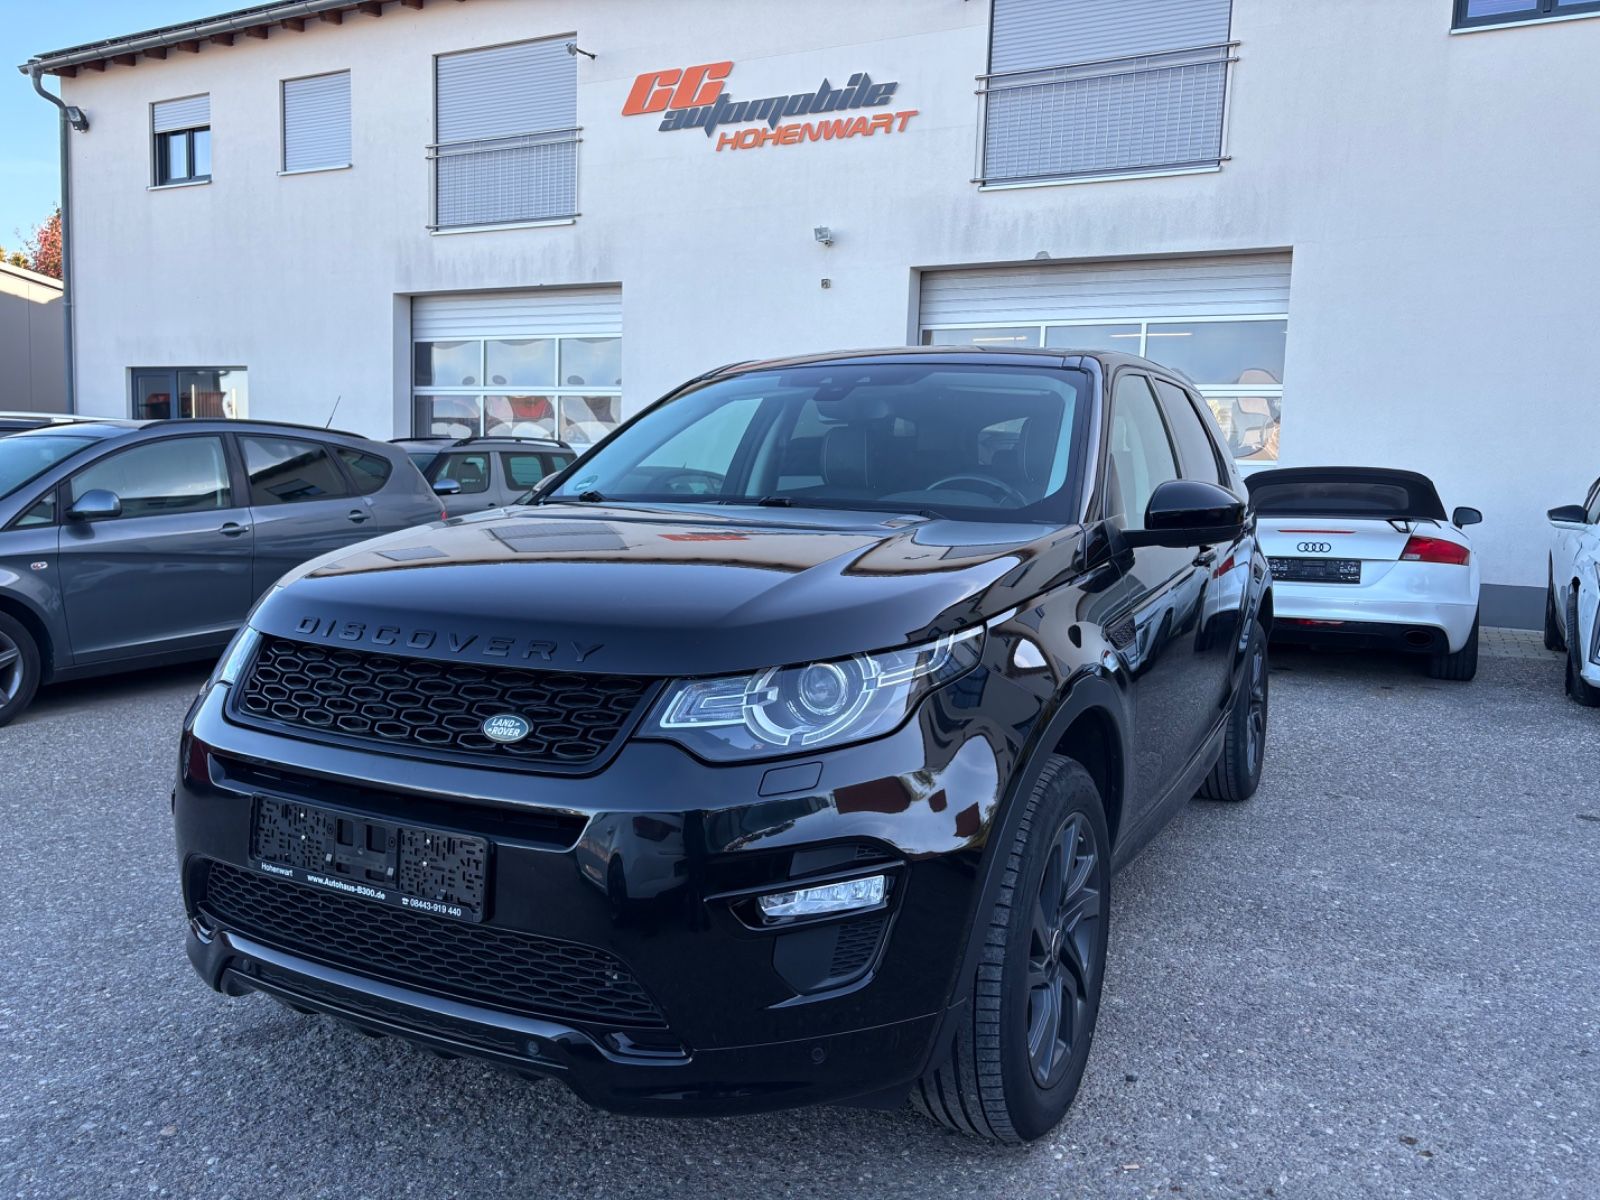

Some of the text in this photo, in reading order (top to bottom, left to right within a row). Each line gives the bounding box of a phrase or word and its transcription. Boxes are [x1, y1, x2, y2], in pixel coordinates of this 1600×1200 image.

[658, 72, 898, 138] automobile
[715, 110, 919, 151] HOHENWART
[295, 615, 605, 662] DISCOVERY
[261, 861, 293, 877] Hohenwart
[306, 874, 386, 900] www.Autohaus-B300.de
